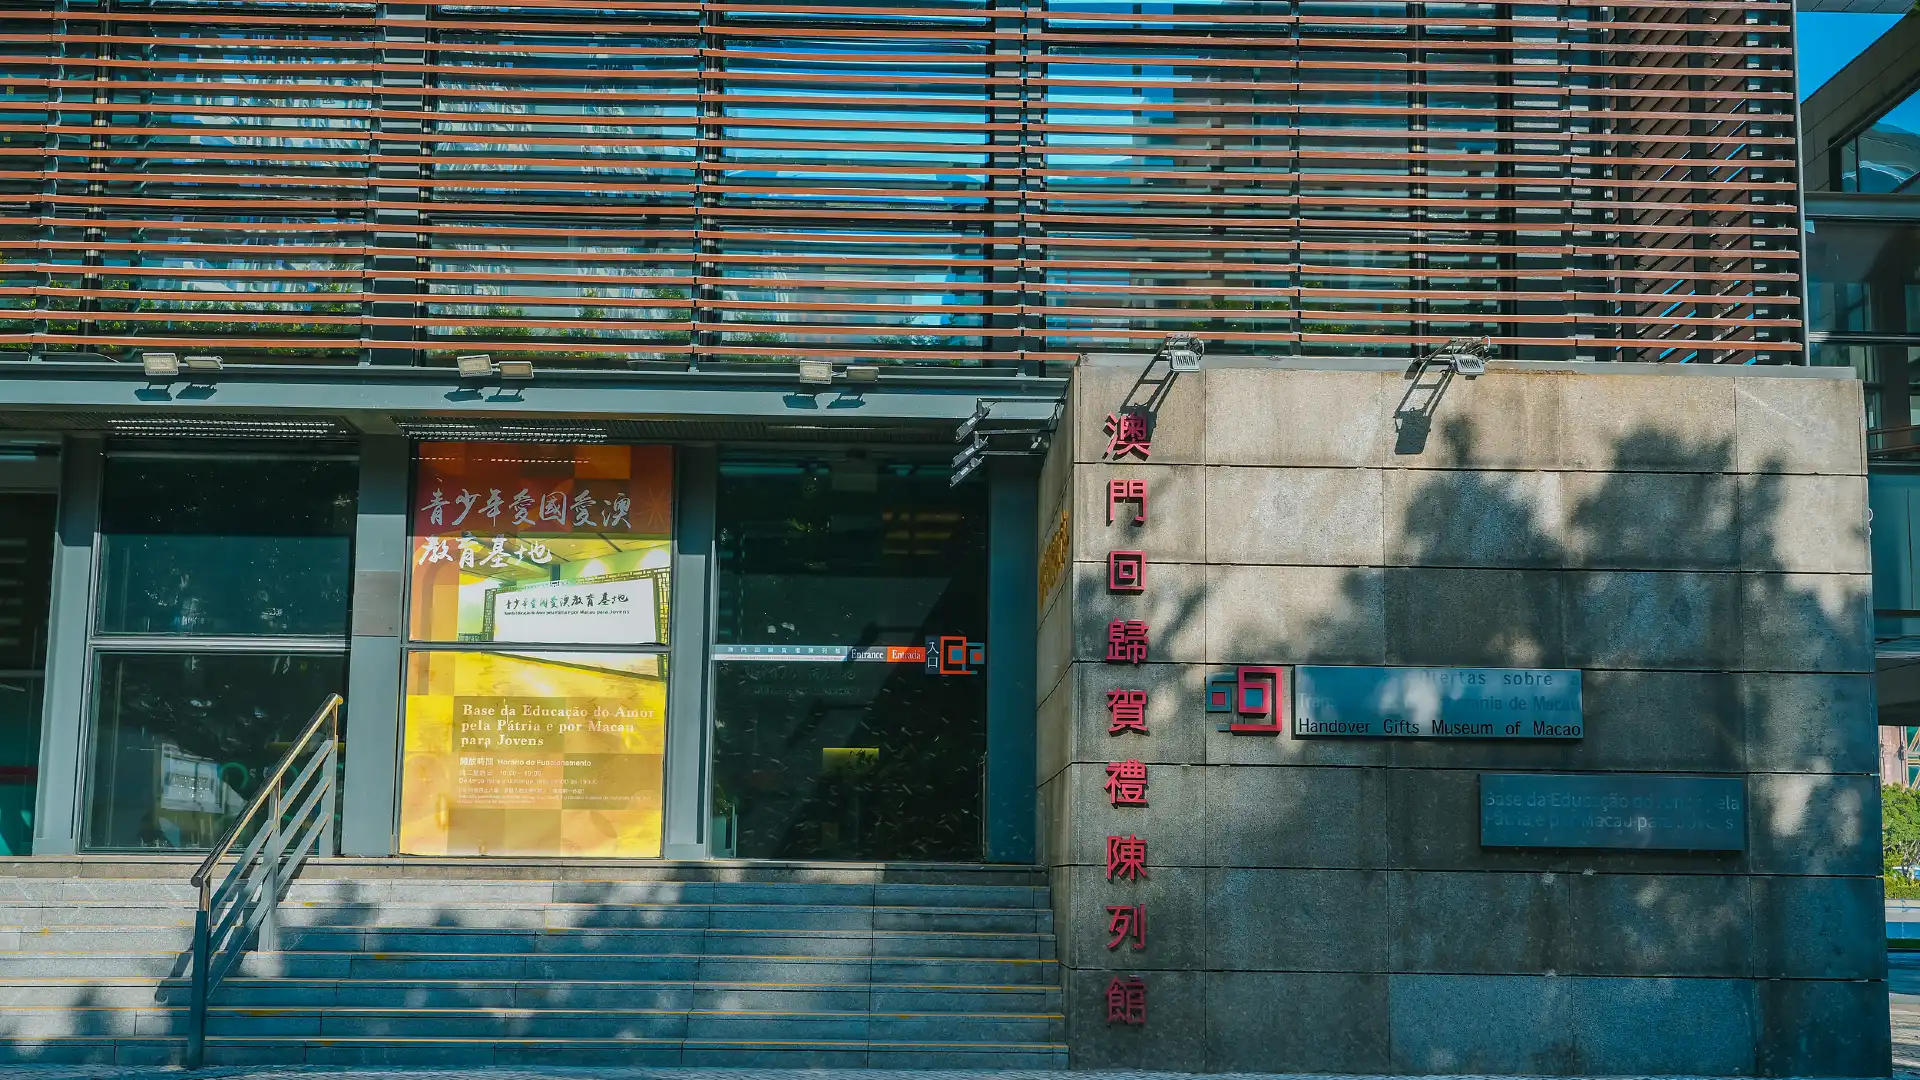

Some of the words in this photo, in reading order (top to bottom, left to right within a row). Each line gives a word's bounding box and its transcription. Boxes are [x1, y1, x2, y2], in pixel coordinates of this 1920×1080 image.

[420, 488, 632, 528] 青少年愛國愛澳
[418, 533, 552, 568] 教育基地
[851, 649, 884, 659] Entrance
[892, 649, 921, 660] Entrada
[926, 641, 939, 668] 入口
[1503, 671, 1552, 685] sobre
[1509, 695, 1527, 710] de
[462, 704, 495, 716] Base
[500, 704, 517, 716] da
[522, 704, 588, 720] Educação
[593, 706, 610, 718] do
[615, 706, 655, 718] Amor
[1103, 412, 1151, 1026] 澳門回歸賀禮陳列館
[461, 720, 492, 733] pela
[497, 720, 540, 731] Pátria
[546, 723, 553, 731] e
[558, 723, 582, 734] por
[588, 721, 635, 732] Macau
[1299, 718, 1371, 733] Handover
[1383, 718, 1420, 734] Gifts
[1431, 719, 1493, 735] Museum
[1505, 720, 1521, 735] of
[1533, 720, 1581, 736] Macao
[461, 737, 491, 748] para
[497, 734, 544, 746] Jovens
